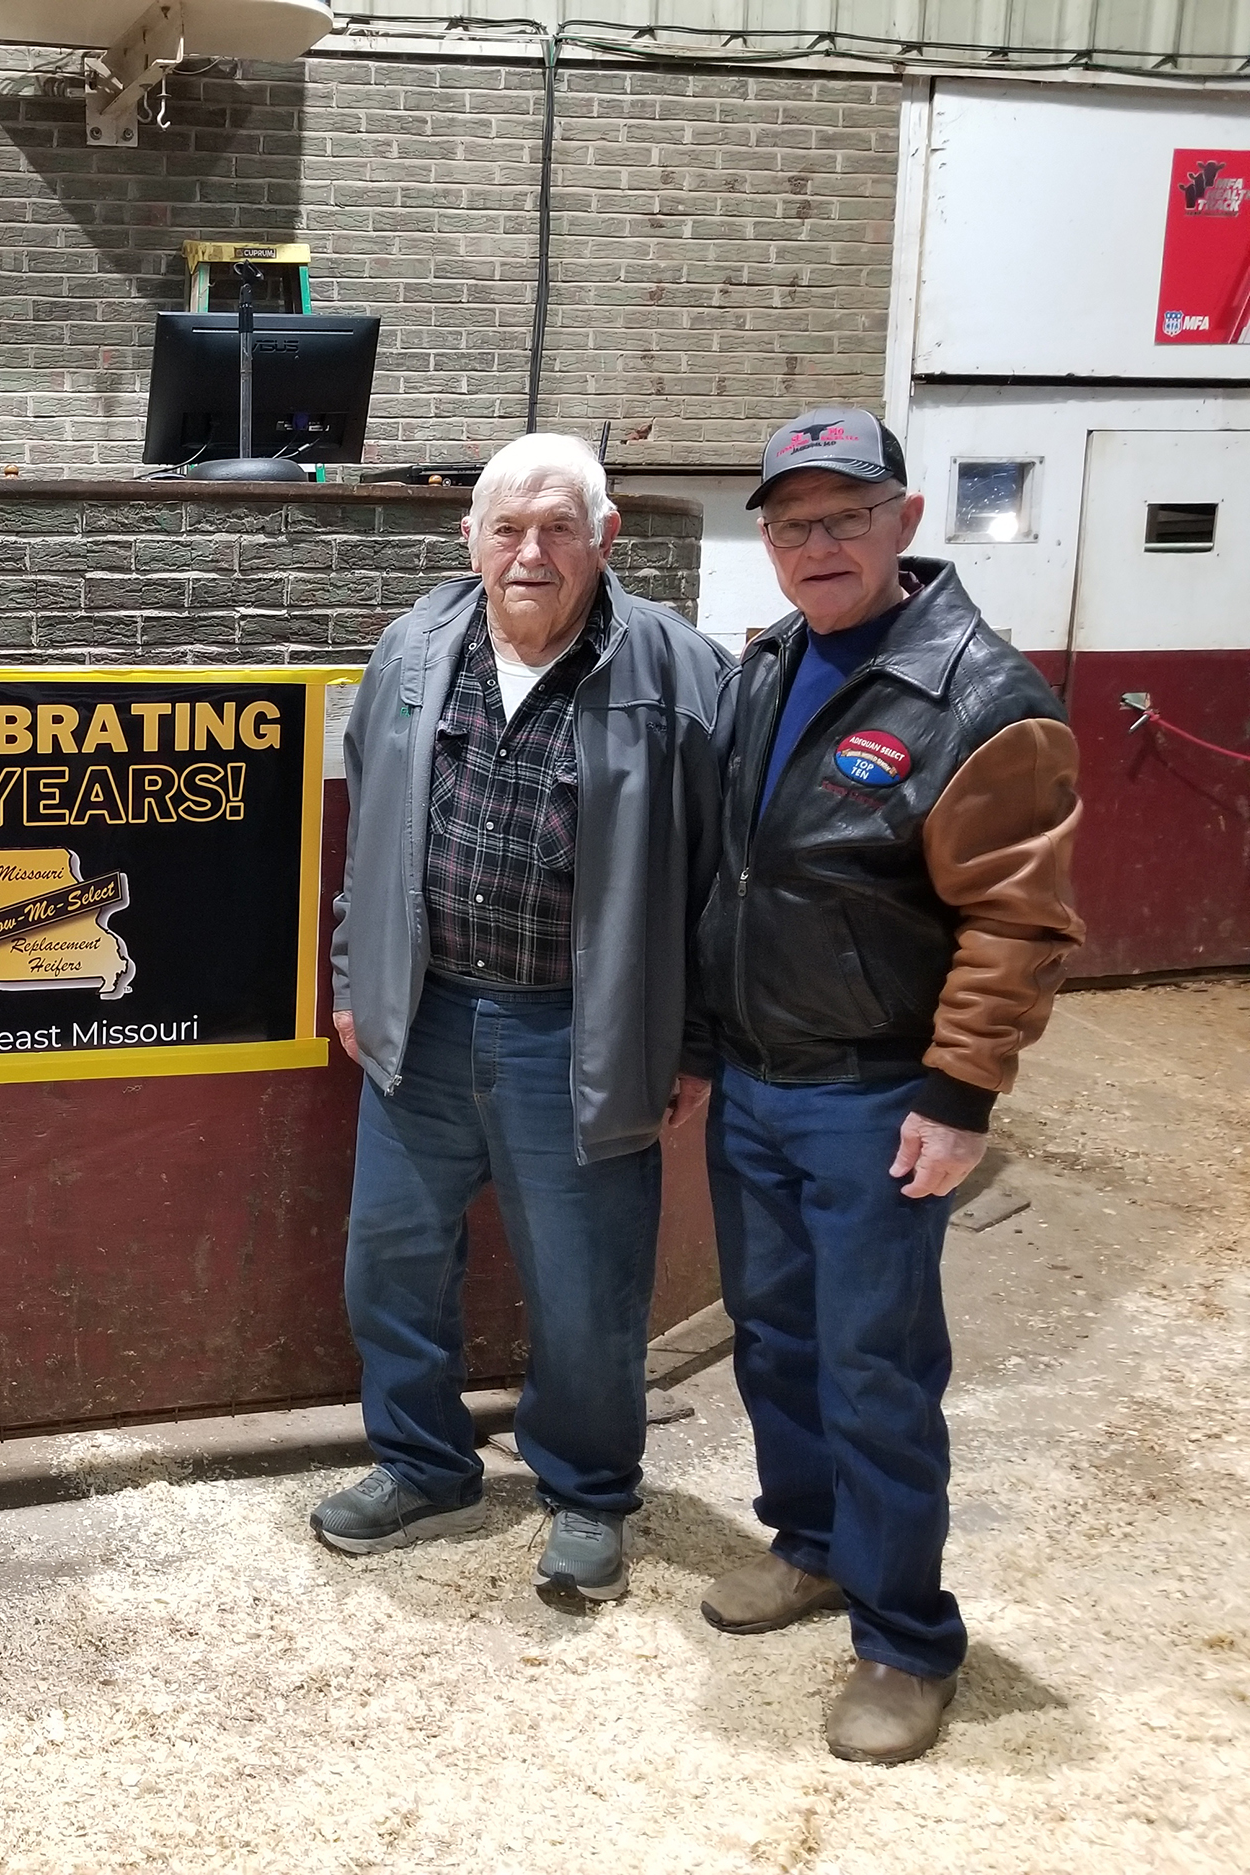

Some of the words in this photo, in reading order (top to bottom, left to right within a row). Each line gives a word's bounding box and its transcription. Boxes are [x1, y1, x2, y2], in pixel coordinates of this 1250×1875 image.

[1216, 178, 1243, 190] MFA
[1197, 199, 1241, 212] TRACK
[1183, 316, 1209, 331] MFA
[252, 339, 299, 354] ASUS
[849, 736, 881, 751] ADEQUAN
[880, 746, 905, 762] SELECT
[855, 758, 874, 771] TOP
[851, 767, 869, 780] TEN
[10, 937, 101, 956] Replacement
[28, 957, 83, 977] Heifers
[72, 1014, 199, 1047] Missouri
